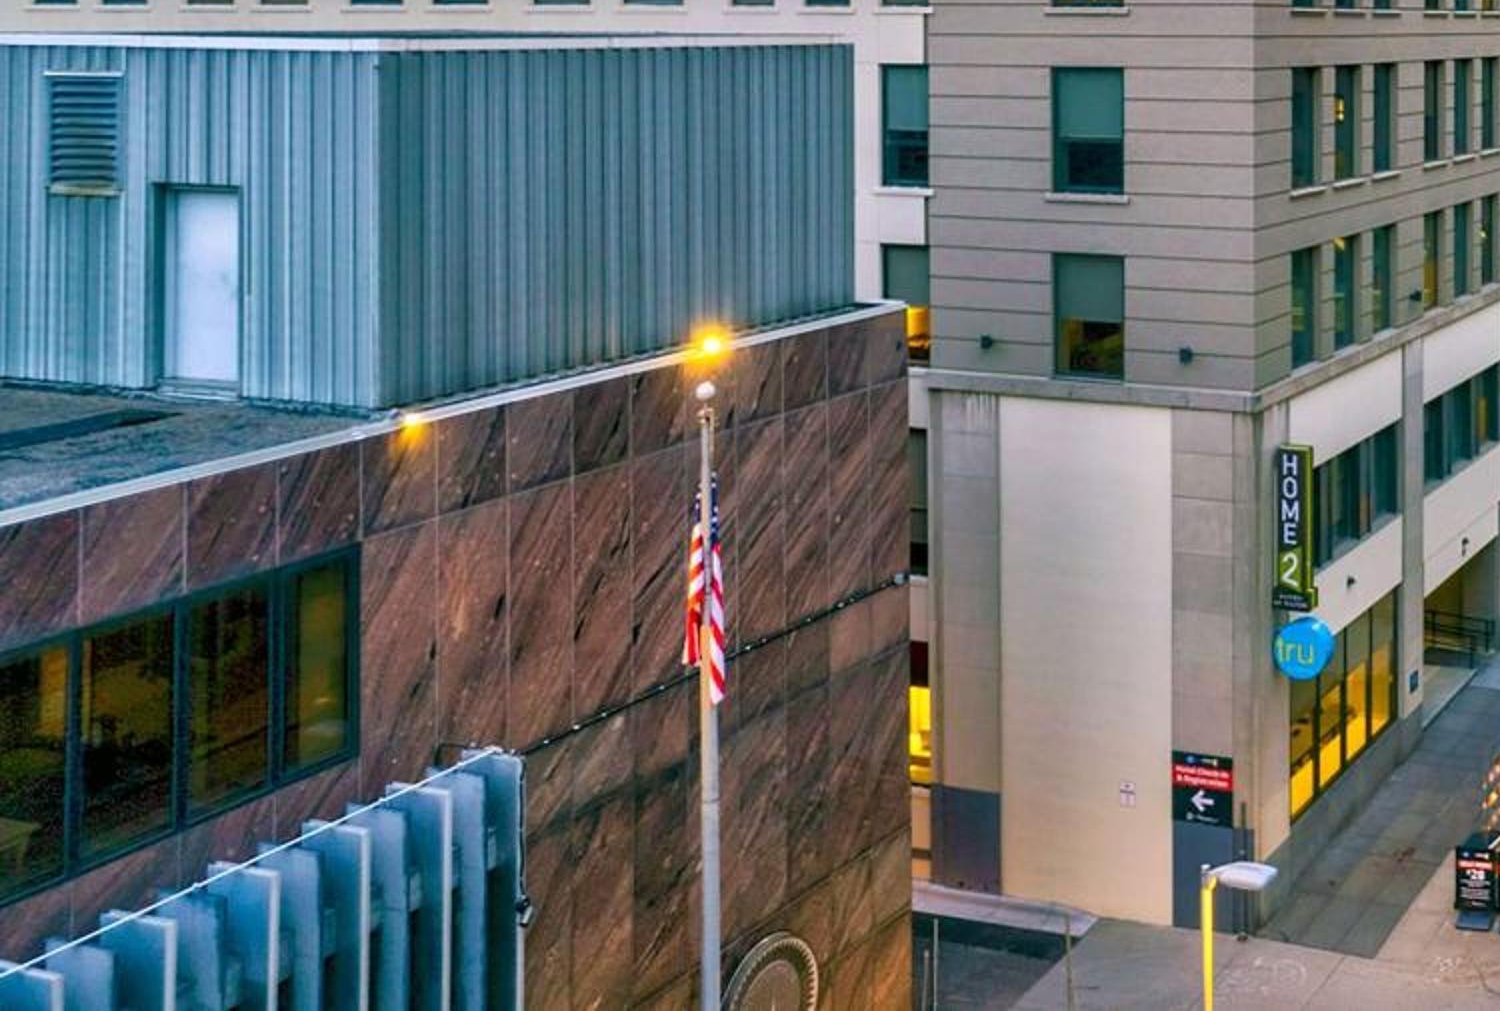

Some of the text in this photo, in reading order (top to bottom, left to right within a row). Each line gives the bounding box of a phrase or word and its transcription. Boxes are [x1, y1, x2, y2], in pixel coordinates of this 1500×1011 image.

[1281, 453, 1300, 545] HOME
[1281, 552, 1299, 587] 2
[1274, 634, 1314, 665] tru
